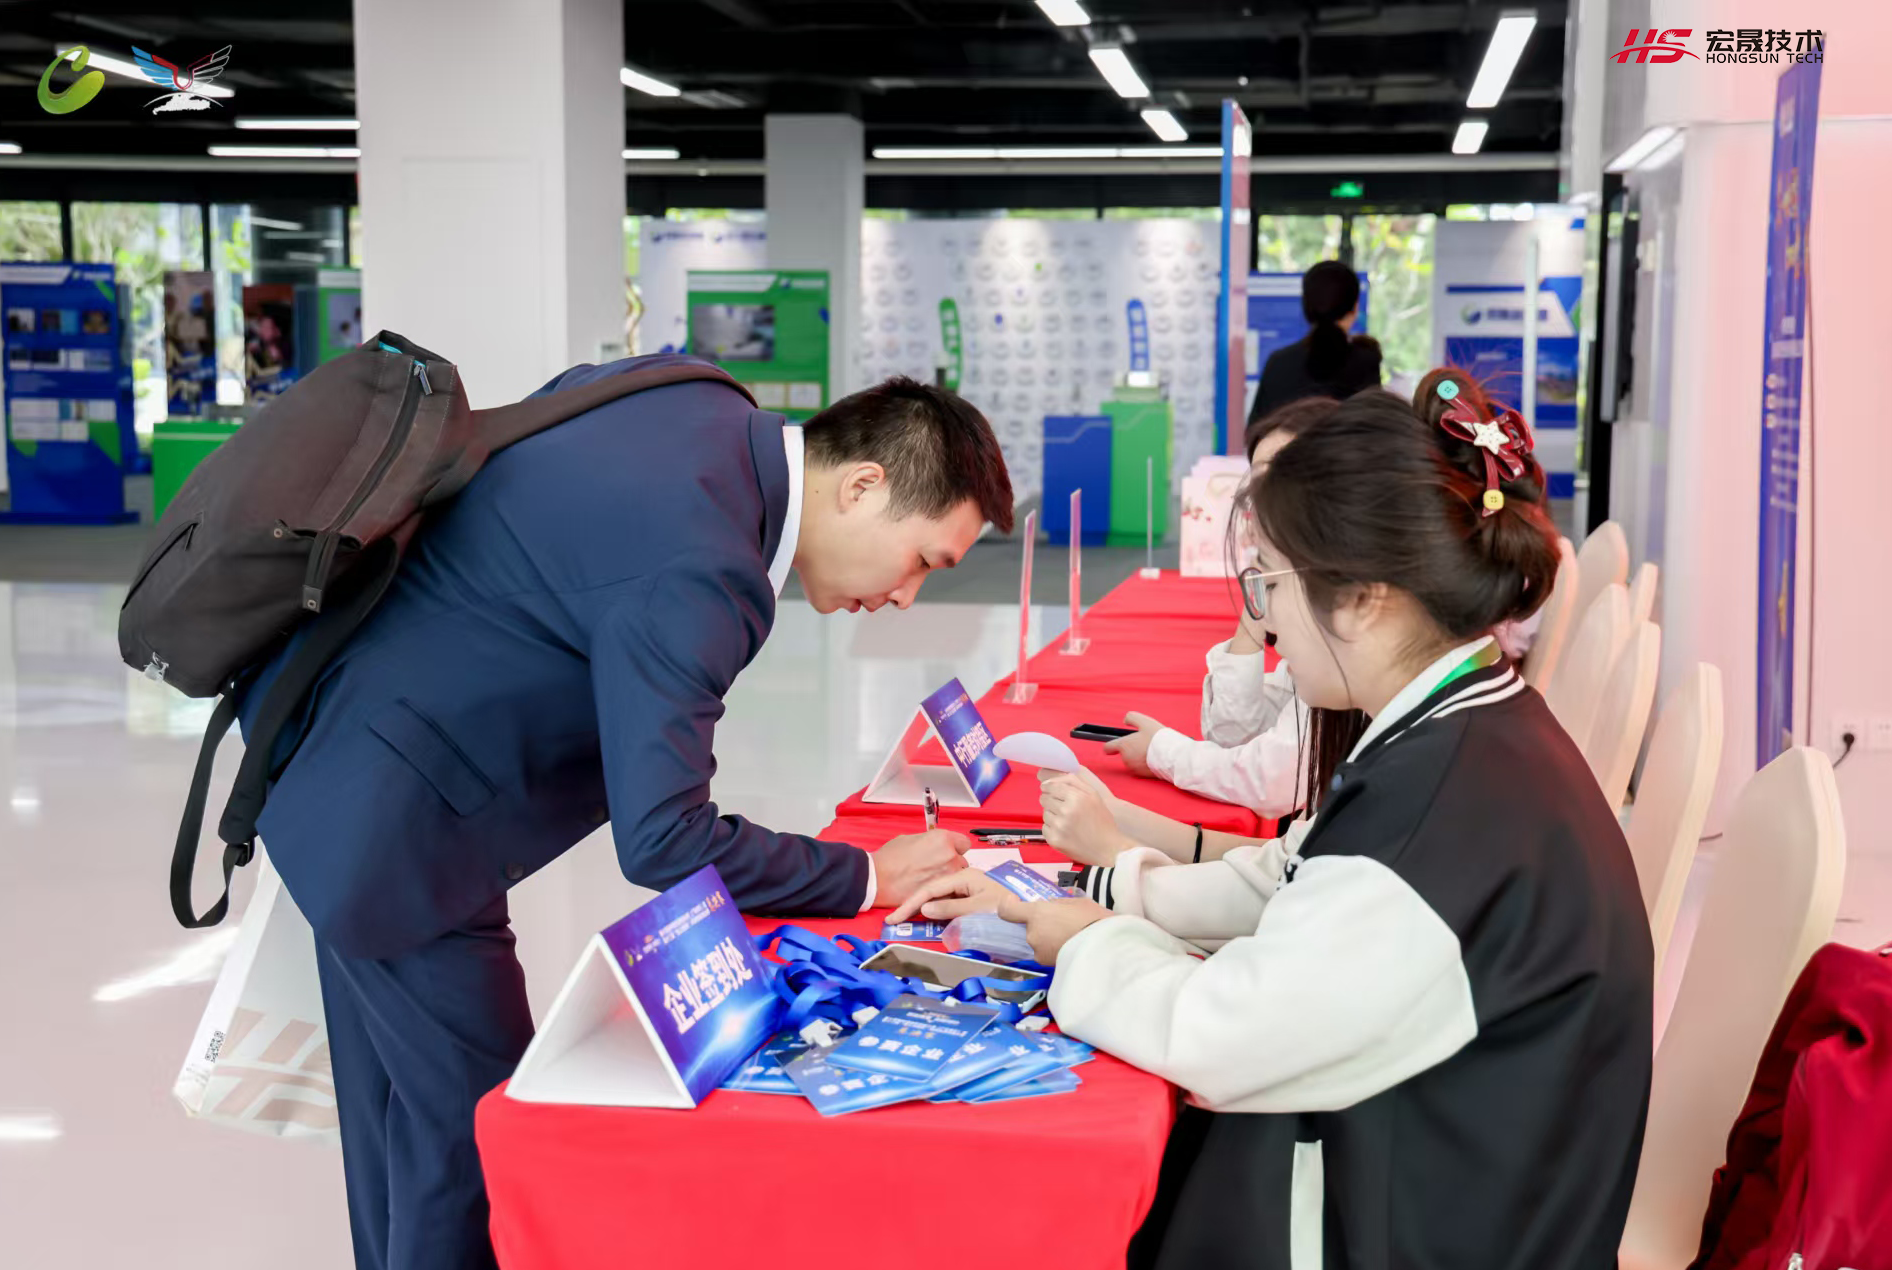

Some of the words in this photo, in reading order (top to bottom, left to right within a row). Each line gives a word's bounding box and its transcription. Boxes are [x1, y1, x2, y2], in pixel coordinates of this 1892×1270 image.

[663, 936, 753, 1034] 企业签到处
